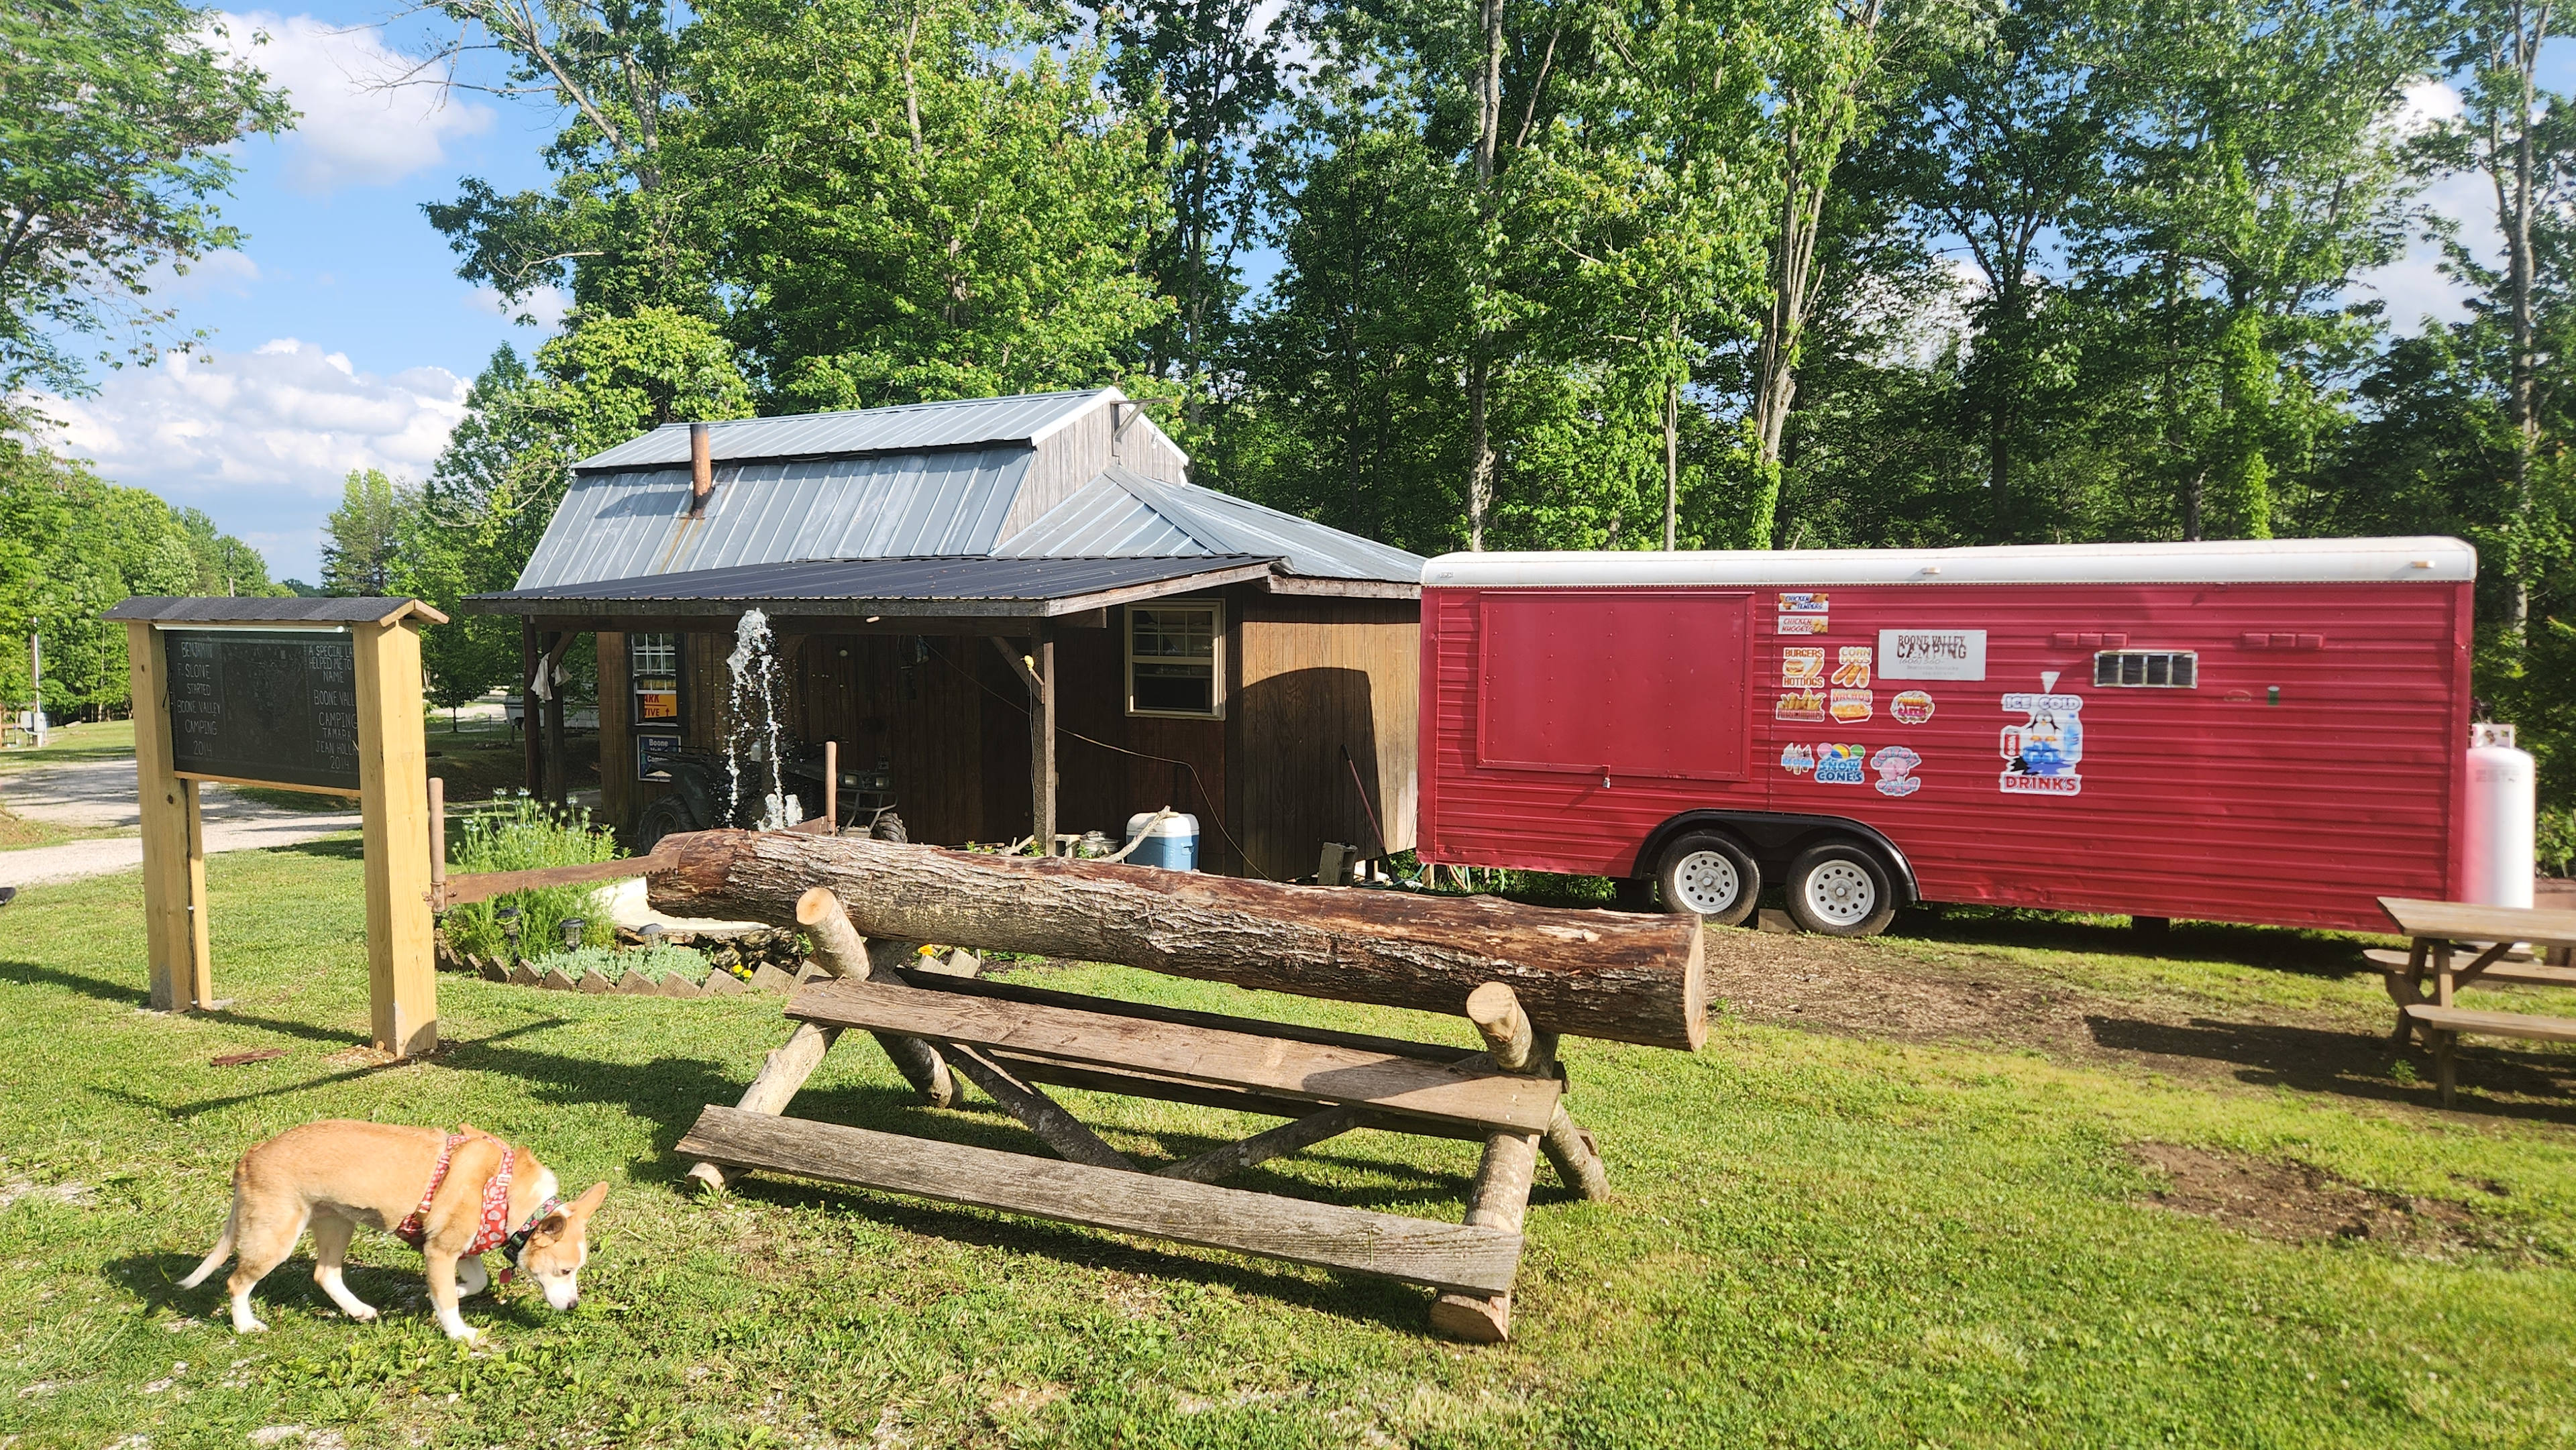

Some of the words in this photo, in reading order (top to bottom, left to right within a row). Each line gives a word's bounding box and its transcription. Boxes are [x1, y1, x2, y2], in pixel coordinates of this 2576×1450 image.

[1898, 635, 1929, 645] BOONE
[1932, 636, 1966, 645] VALLEY
[181, 642, 213, 658] BENJAMIN
[309, 645, 314, 657] A
[315, 645, 343, 658] SPECIAL
[1784, 649, 1823, 657] BURGERS
[1841, 649, 1871, 657] CORN
[1896, 644, 1967, 659] CAMPING
[185, 663, 211, 679] SLONE
[309, 657, 332, 670] HELPED
[343, 658, 352, 671] TO
[323, 671, 344, 683] NAME
[1784, 677, 1823, 686] HOTDOGS
[187, 683, 211, 695] STARTED
[313, 689, 337, 706] BOONE
[1833, 691, 1871, 702] NACHOS
[2006, 696, 2032, 709] ICE
[2039, 697, 2080, 710] COLD
[177, 700, 197, 713] BOONE
[198, 702, 220, 715] VALLEY
[184, 719, 217, 735] CAMPING
[319, 712, 358, 729] CAMPING
[322, 728, 352, 741] TAMARA
[193, 740, 213, 757] 2014
[316, 740, 334, 754] JEAN
[649, 738, 669, 746] Boone
[329, 755, 350, 769] 2014
[1872, 746, 1920, 769] COTTON
[1819, 759, 1860, 771] SNOW
[1816, 771, 1864, 782] CONES
[2005, 775, 2077, 791] DRINKS
